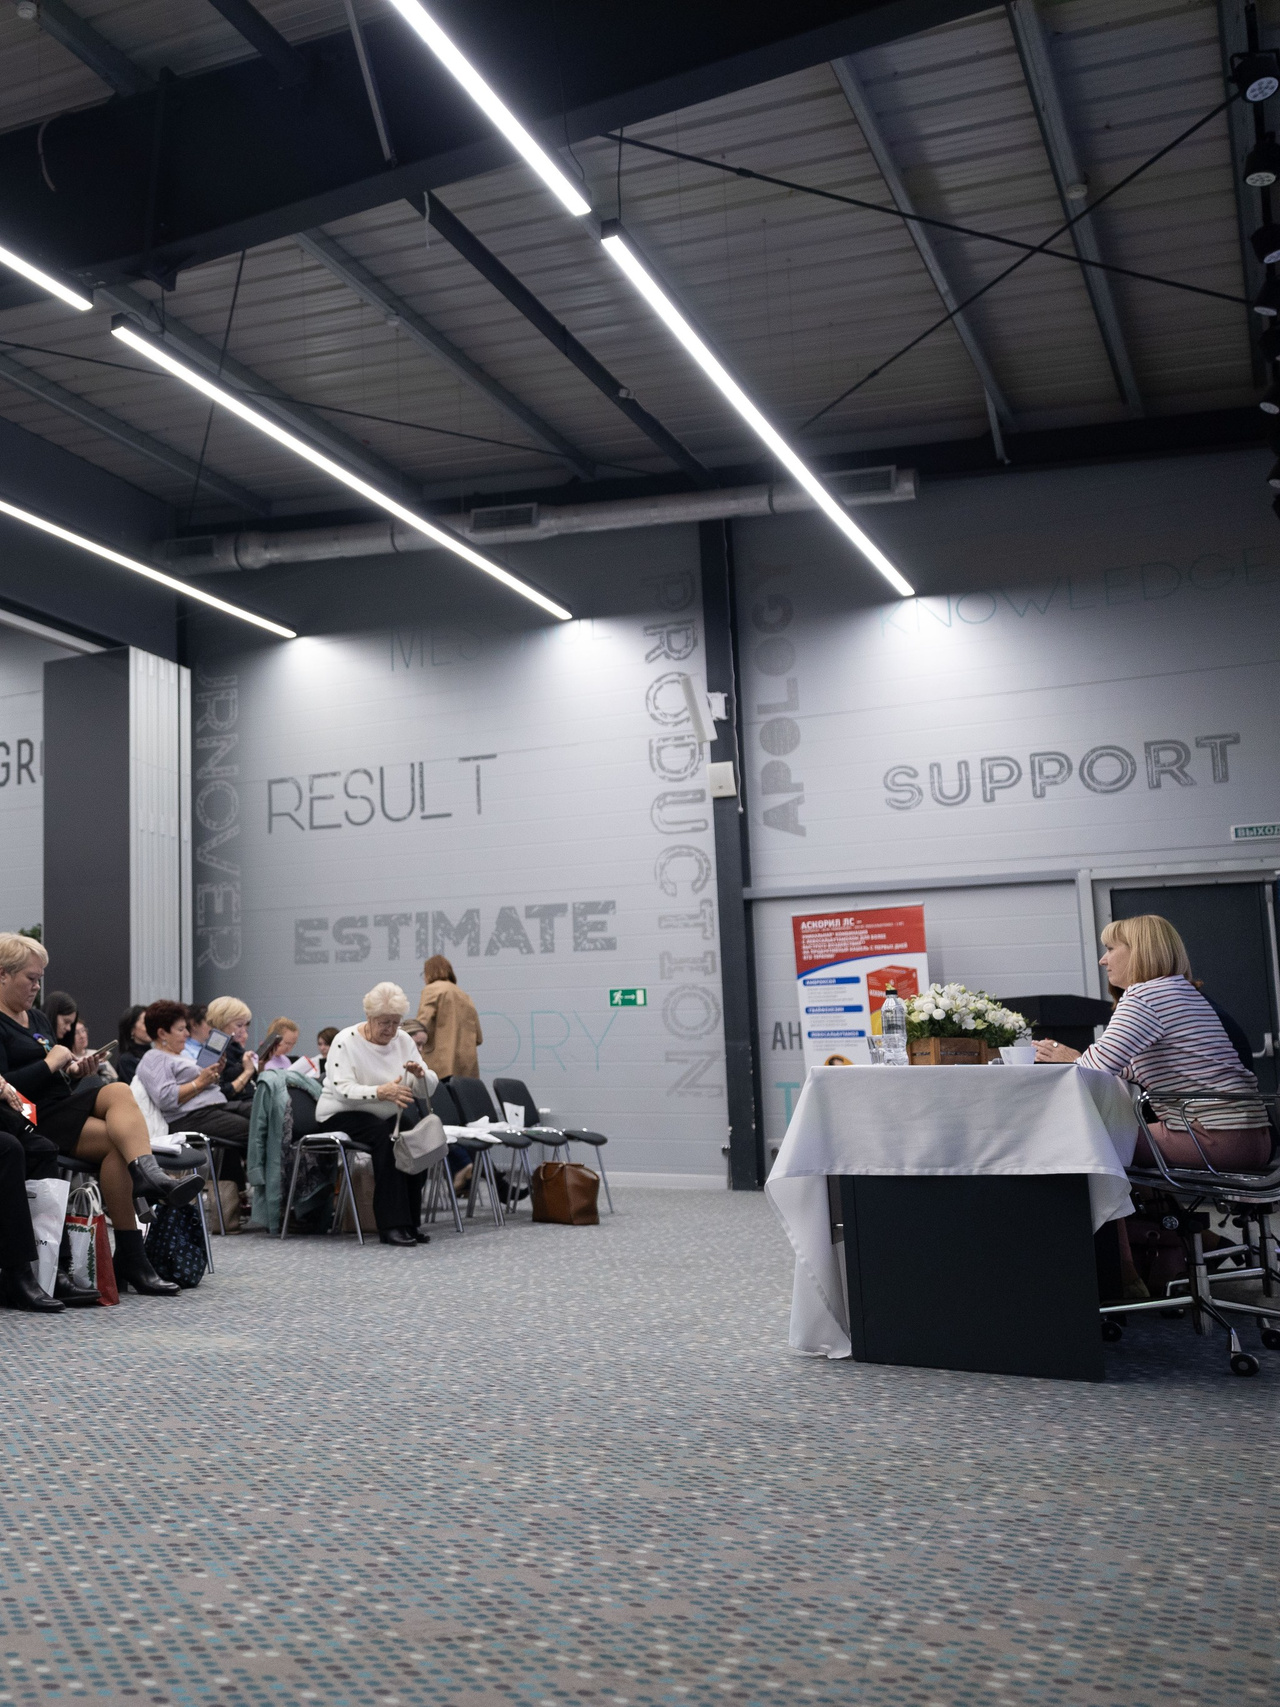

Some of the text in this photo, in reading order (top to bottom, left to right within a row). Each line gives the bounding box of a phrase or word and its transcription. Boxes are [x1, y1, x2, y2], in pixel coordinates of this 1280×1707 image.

[878, 546, 1279, 637] KNOWLEDGE
[267, 753, 498, 835] RESULT
[882, 732, 1241, 811] SUPPORT
[642, 572, 724, 1099] PRODUCTION
[293, 899, 618, 965] ESTIMATE
[801, 918, 841, 930] АСКОРИЛ
[843, 917, 855, 927] ЛС
[771, 1021, 803, 1051] AH
